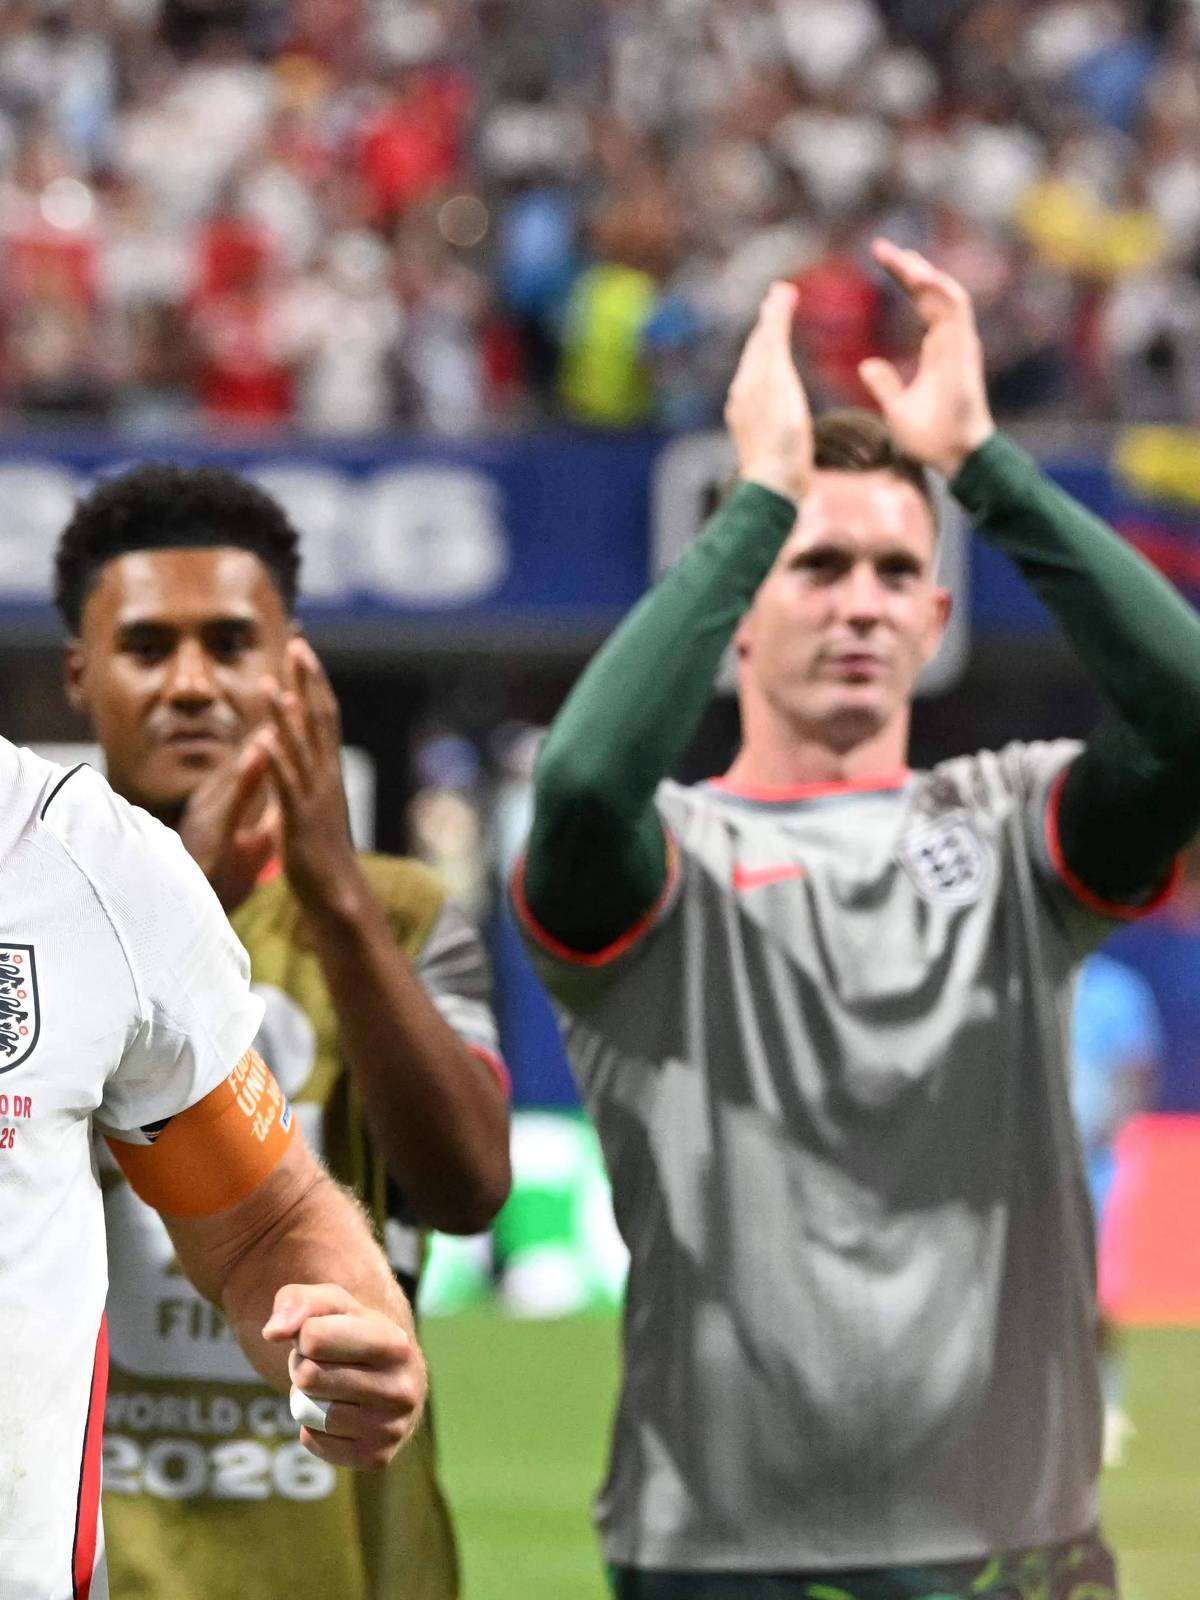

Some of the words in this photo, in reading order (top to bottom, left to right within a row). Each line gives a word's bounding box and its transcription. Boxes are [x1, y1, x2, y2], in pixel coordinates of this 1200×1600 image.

[13, 1095, 32, 1118] DR
[247, 1396, 300, 1436] CU
[102, 1437, 337, 1500] 2026
